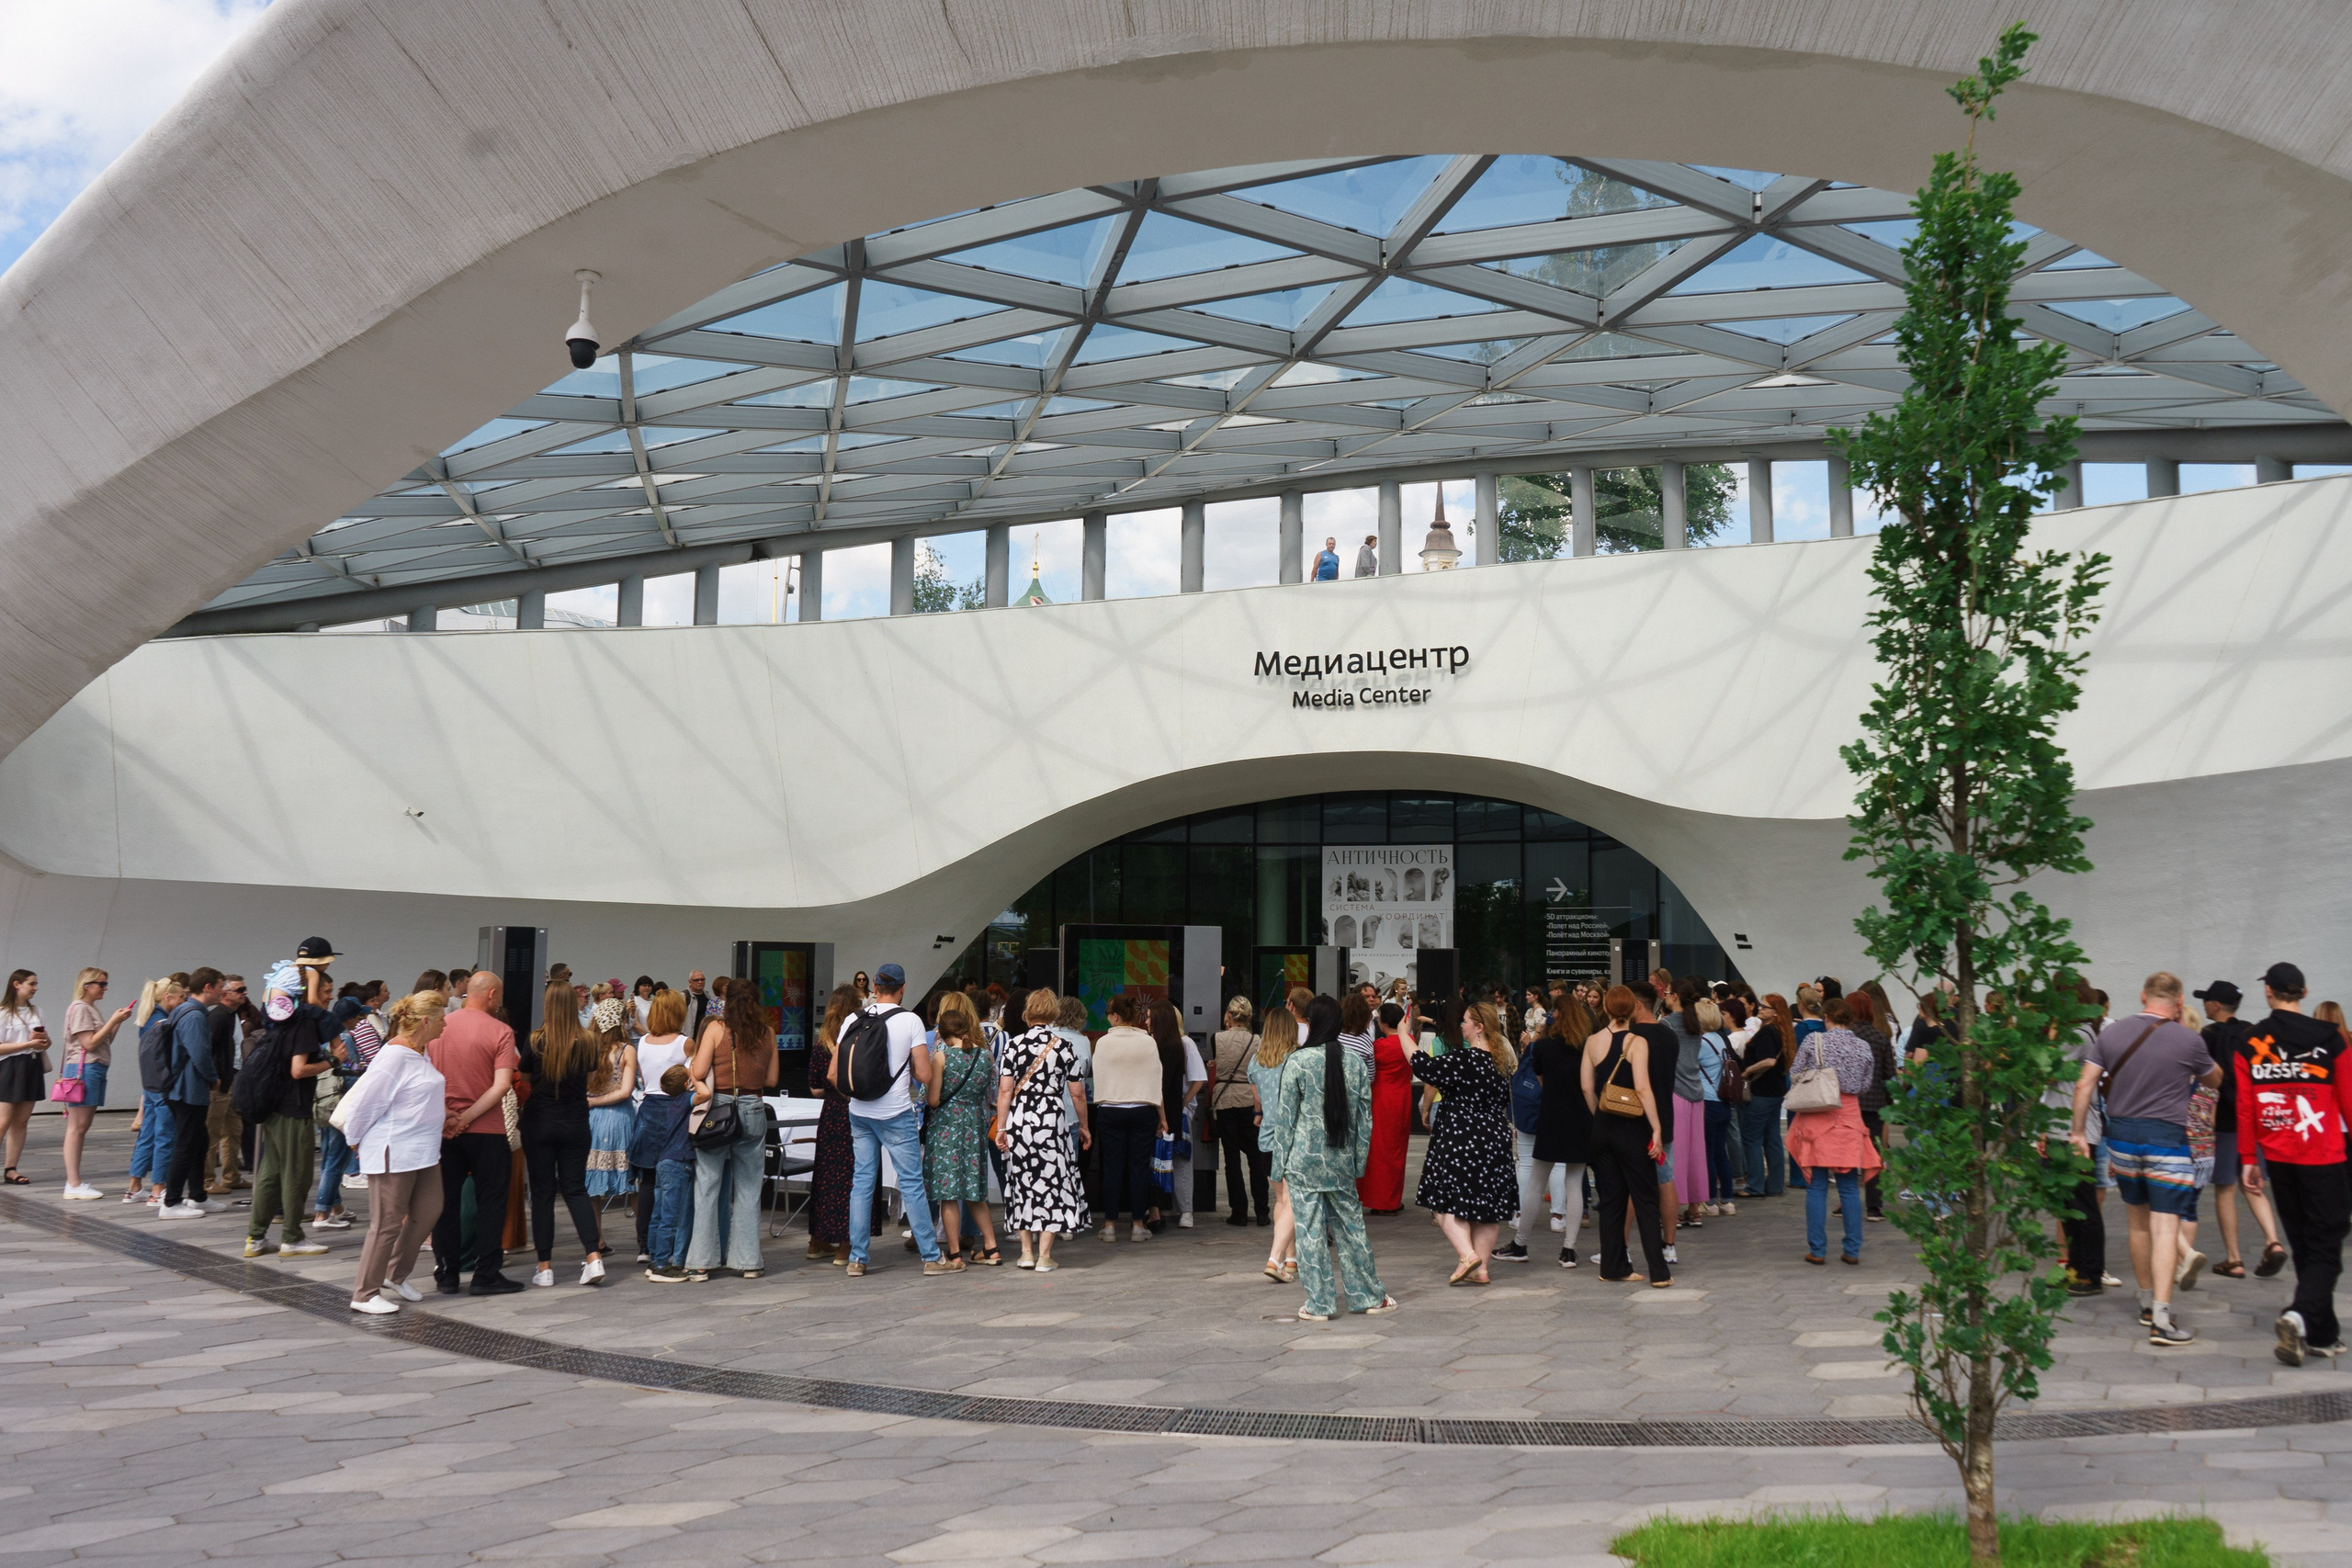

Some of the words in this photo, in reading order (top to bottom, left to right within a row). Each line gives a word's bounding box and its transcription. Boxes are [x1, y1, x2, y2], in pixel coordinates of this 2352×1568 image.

[1254, 645, 1469, 681] Медиацентр
[1293, 689, 1354, 707] Media
[1359, 687, 1431, 704] Center
[1327, 850, 1448, 864] АНТИЧНОСТЬ
[1378, 912, 1445, 920] КООРДИНАТ
